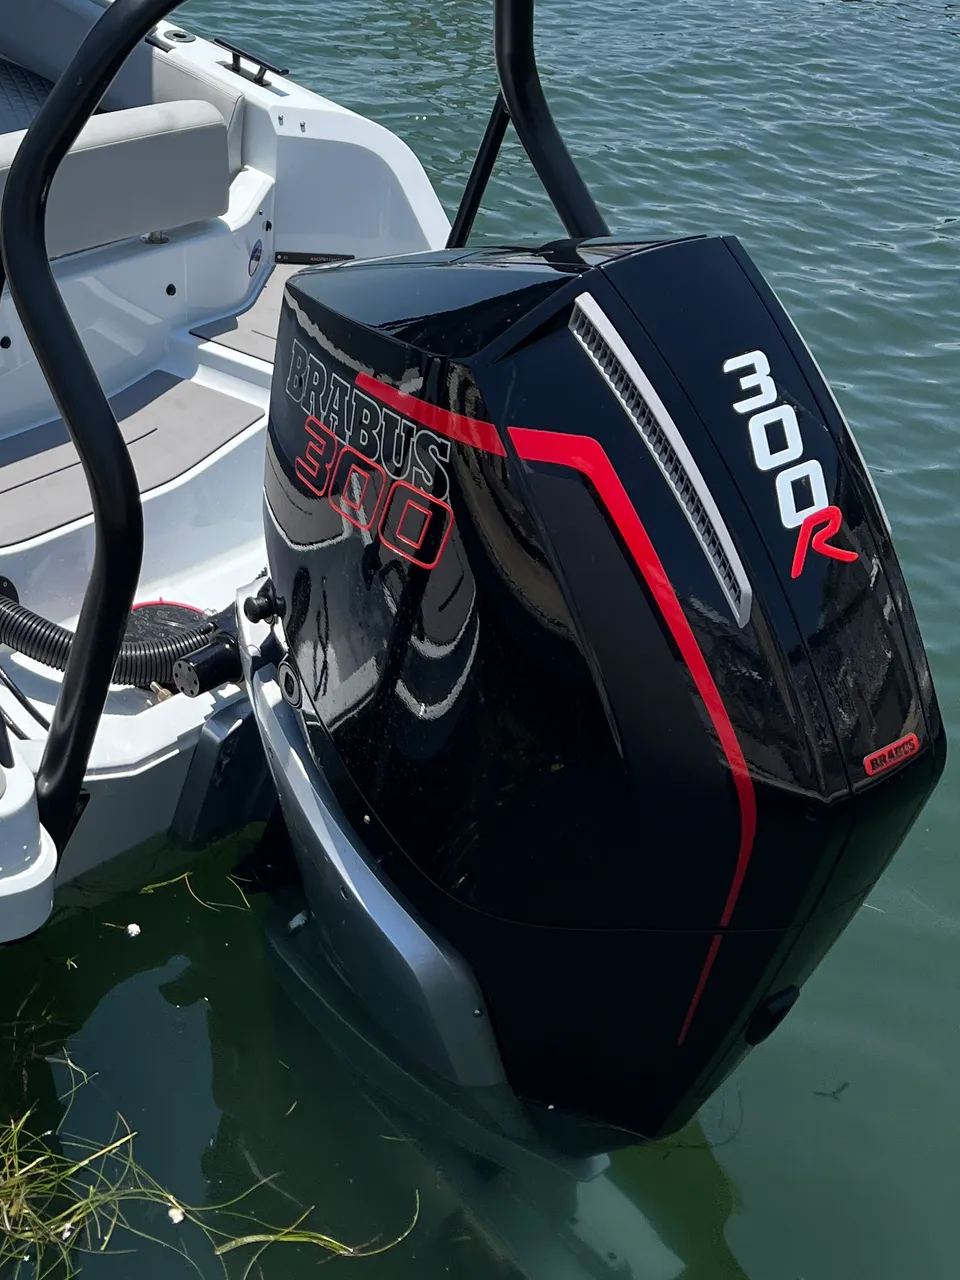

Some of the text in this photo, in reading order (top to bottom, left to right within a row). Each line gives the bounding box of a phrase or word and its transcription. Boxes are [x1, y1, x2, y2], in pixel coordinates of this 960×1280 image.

[286, 338, 451, 503] BRABUS
[295, 415, 455, 570] 300
[869, 738, 915, 771] BRABUS
